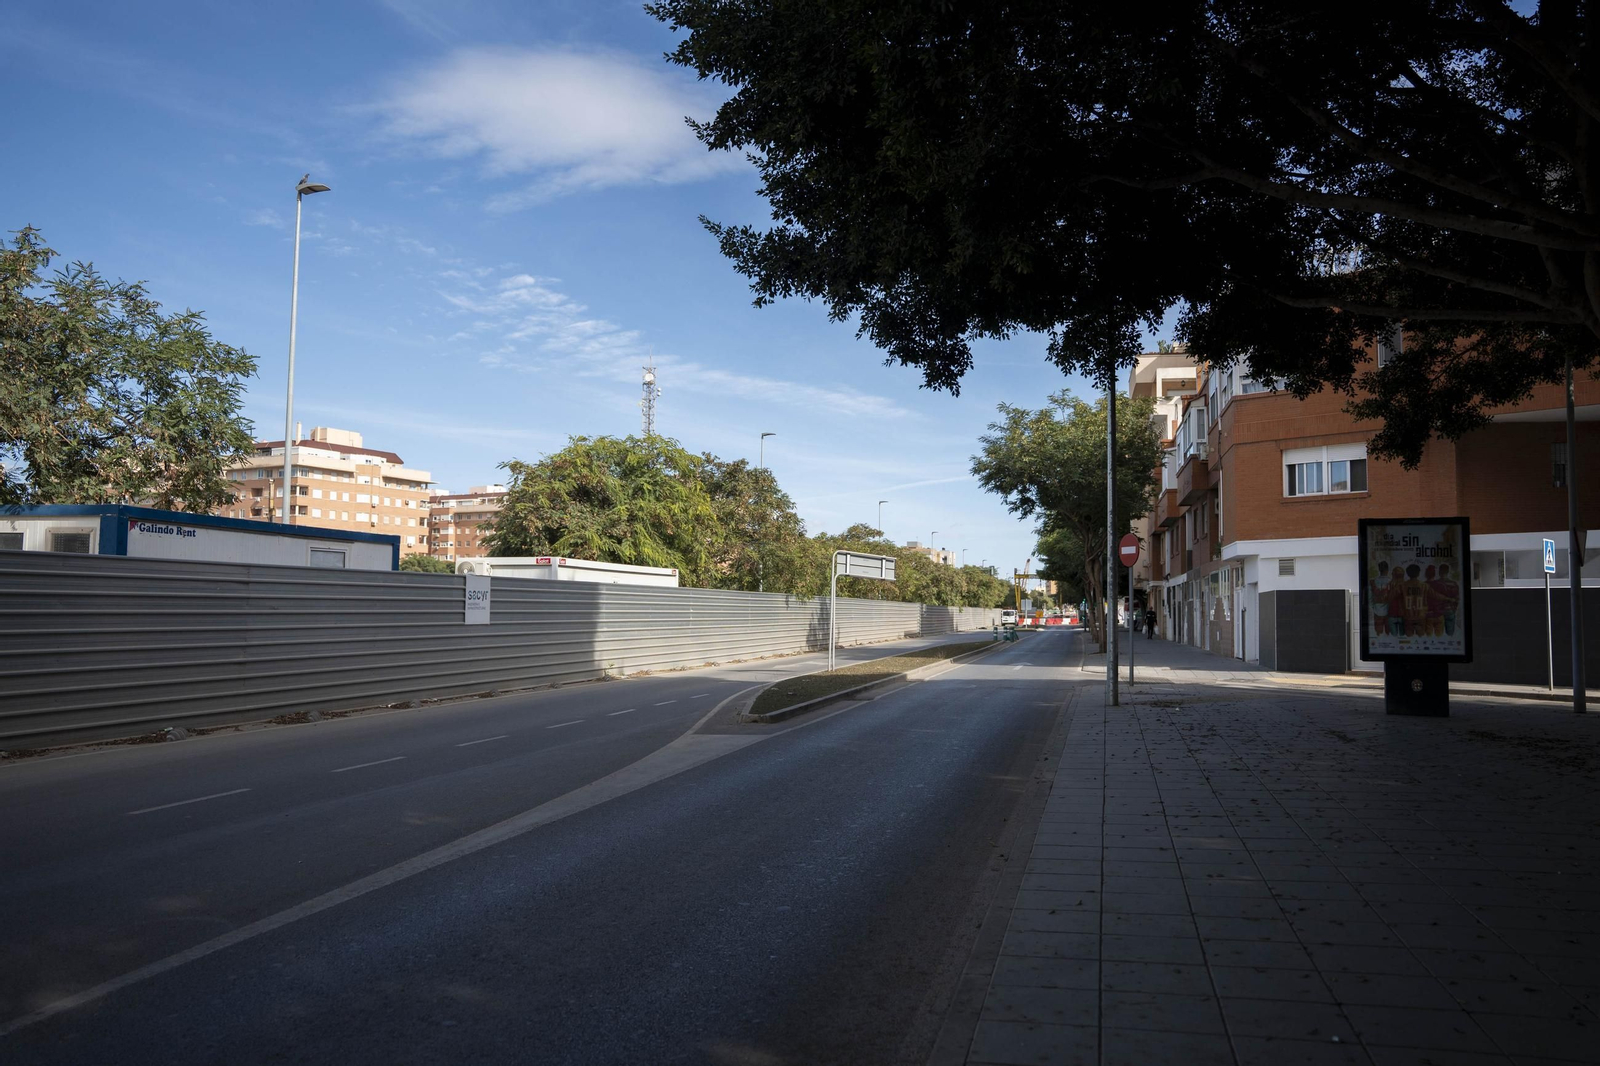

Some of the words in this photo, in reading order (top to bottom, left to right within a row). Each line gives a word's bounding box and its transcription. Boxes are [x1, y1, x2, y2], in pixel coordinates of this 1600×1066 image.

[139, 522, 174, 534] Galindo
[176, 526, 196, 538] Rent
[1402, 533, 1419, 547] sin
[1416, 544, 1453, 557] alcohol
[467, 590, 488, 601] sacyr
